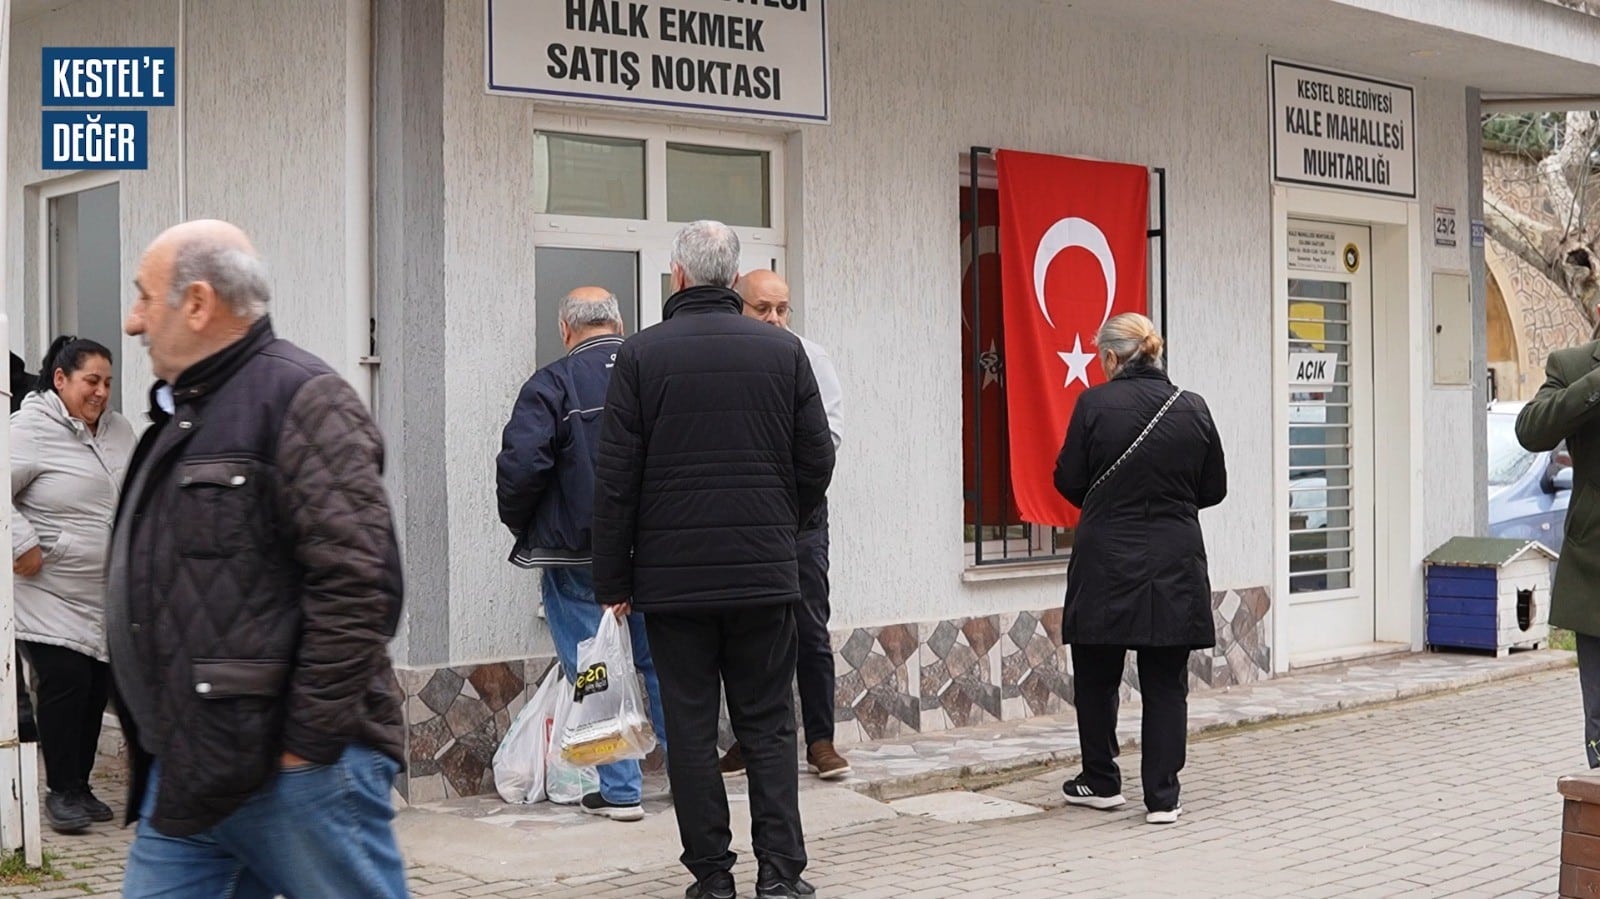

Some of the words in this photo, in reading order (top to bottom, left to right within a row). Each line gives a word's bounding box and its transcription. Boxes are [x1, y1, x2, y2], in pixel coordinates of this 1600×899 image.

[565, 0, 649, 39] HALK
[660, 8, 765, 52] EKMEK
[547, 43, 640, 91] SATIŞ
[652, 54, 781, 100] NOKTASI
[1298, 80, 1334, 104] KESTEL
[1338, 86, 1392, 114] BELEDİYESİ
[1286, 106, 1322, 137] KALE
[1327, 113, 1404, 150] MAHALLESİ
[1304, 148, 1390, 185] MUHTARLIĞI
[1436, 217, 1456, 236] 25/2
[1296, 360, 1326, 381] AÇIK
